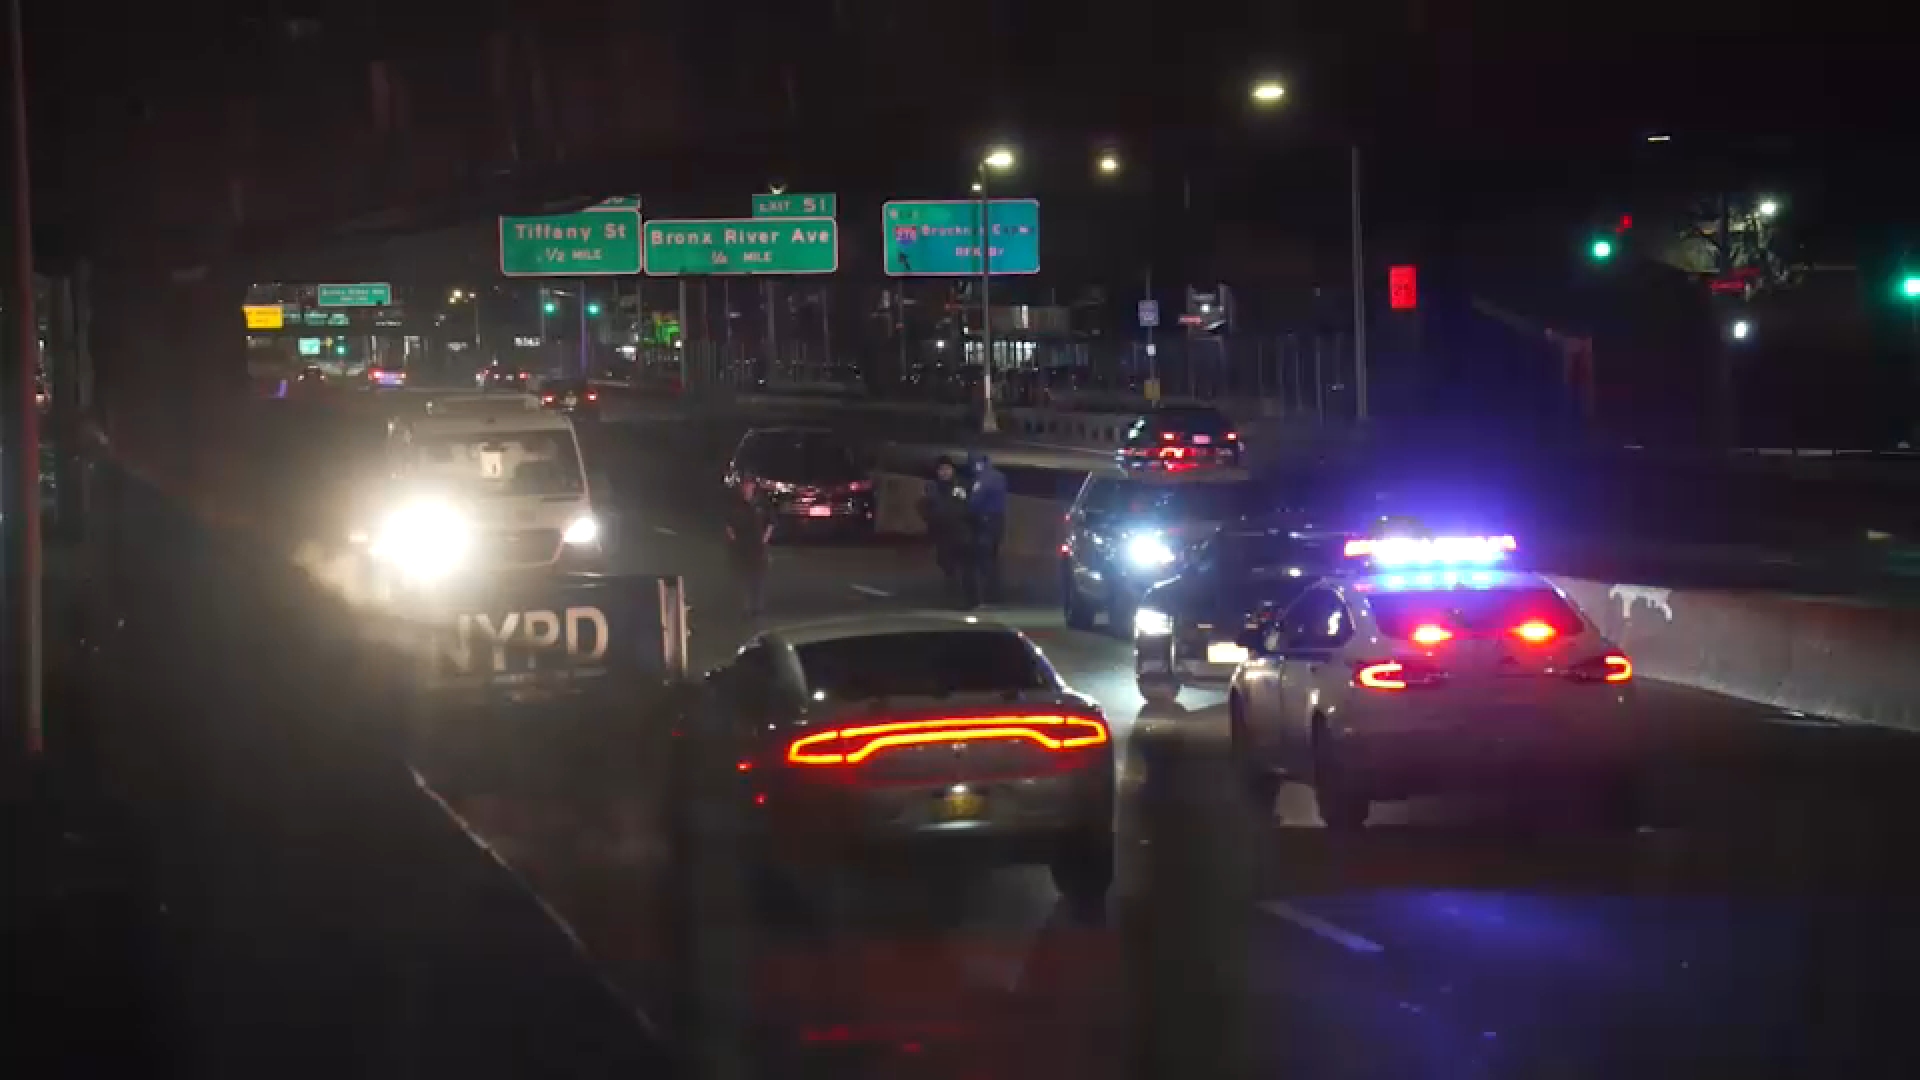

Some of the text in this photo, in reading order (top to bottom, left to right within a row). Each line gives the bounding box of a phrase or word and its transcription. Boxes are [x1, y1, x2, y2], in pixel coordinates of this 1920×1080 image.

[515, 223, 627, 243] Tiffany St
[651, 227, 829, 246] Bronx River Ave
[571, 248, 603, 261] MILE
[743, 251, 773, 263] MILE
[430, 606, 609, 671] NYPD
